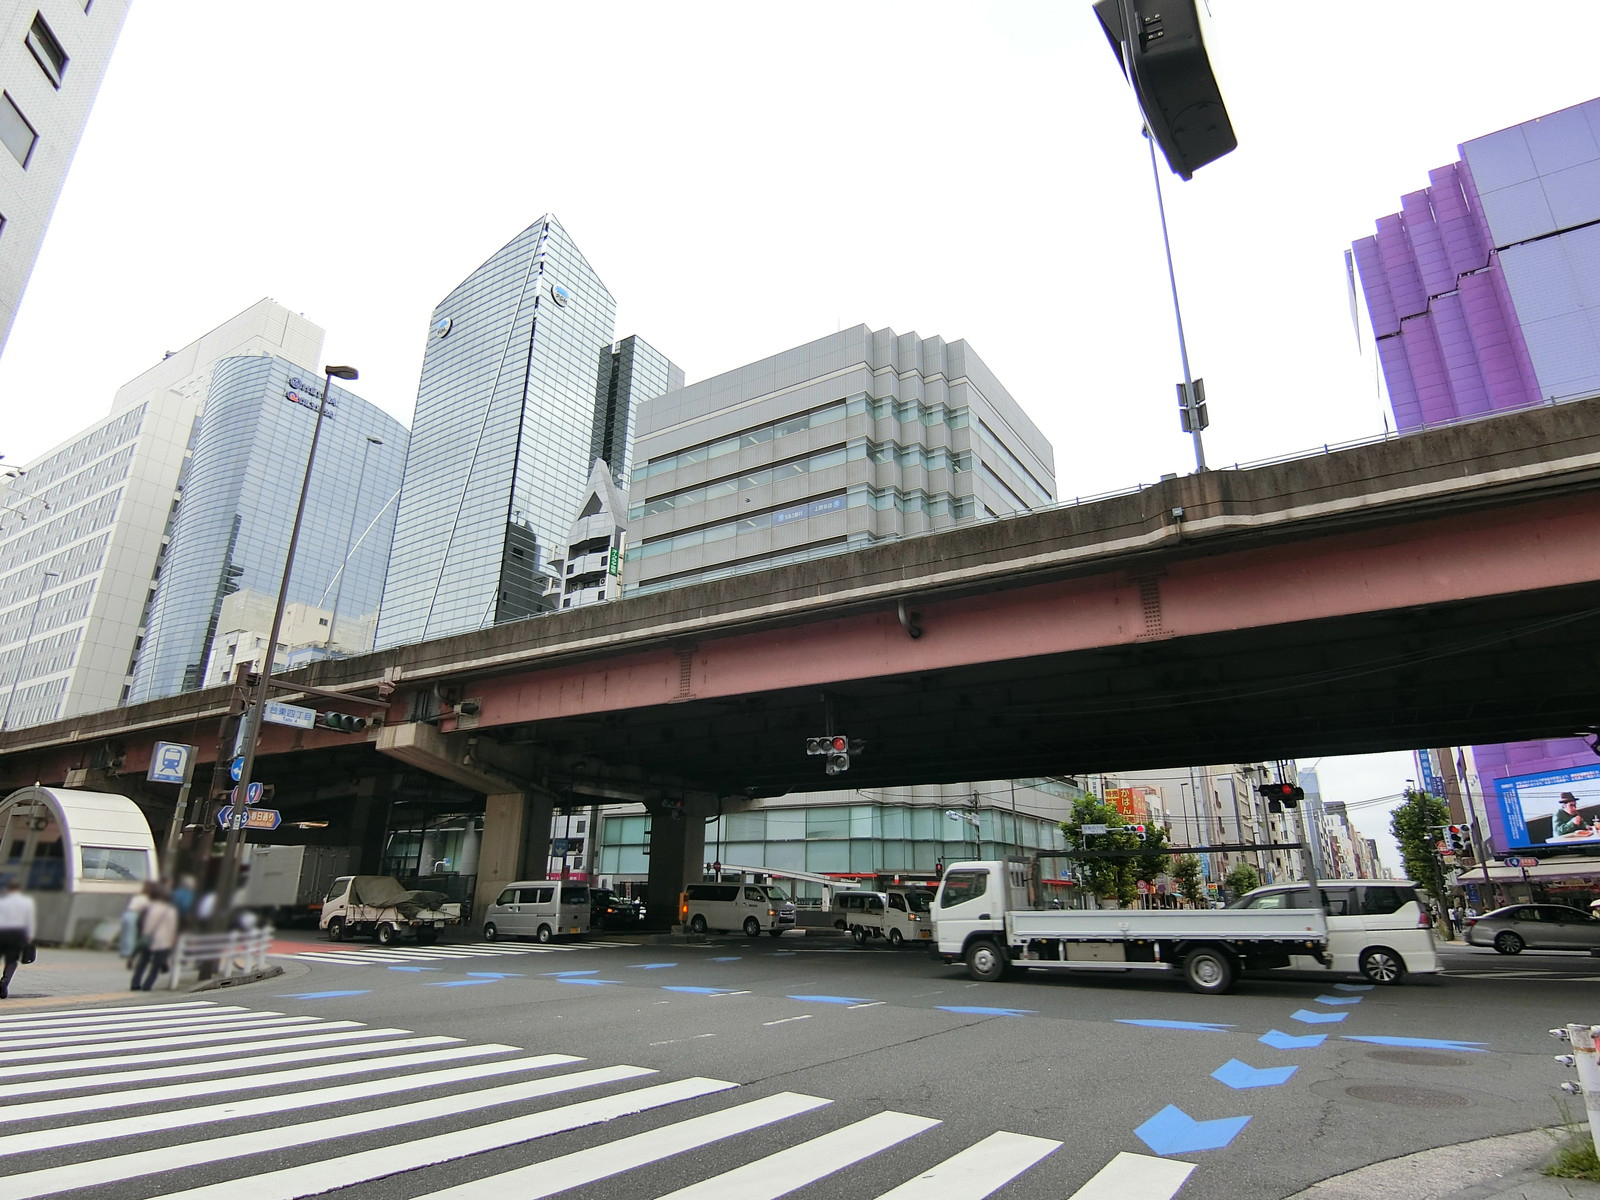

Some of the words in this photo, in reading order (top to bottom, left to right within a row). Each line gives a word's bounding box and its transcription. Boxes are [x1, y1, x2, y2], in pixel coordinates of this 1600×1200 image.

[270, 705, 312, 721] 台東四丁目
[249, 786, 256, 798] 4
